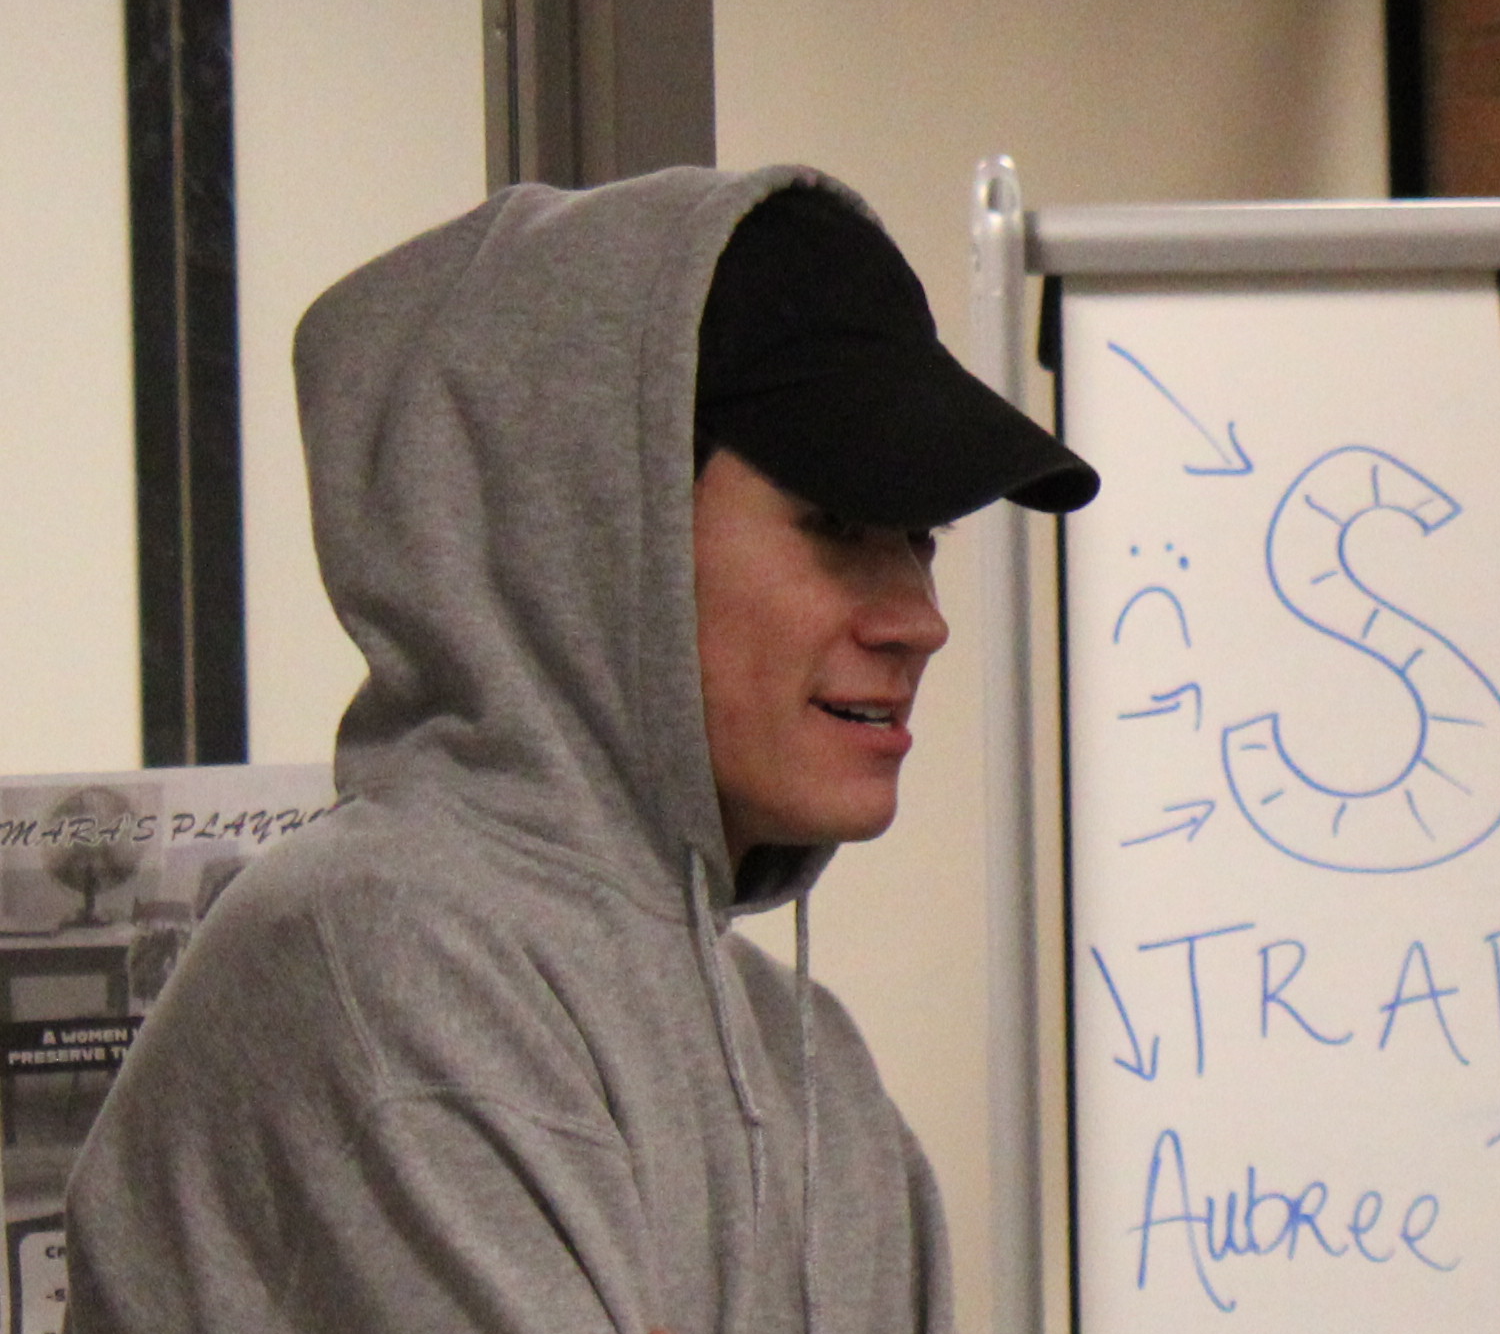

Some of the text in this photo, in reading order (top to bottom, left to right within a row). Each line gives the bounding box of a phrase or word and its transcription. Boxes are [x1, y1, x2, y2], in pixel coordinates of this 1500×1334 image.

[42, 1030, 57, 1045] A
[61, 1028, 129, 1044] WOMEN
[8, 1047, 106, 1065] PRESERVE
